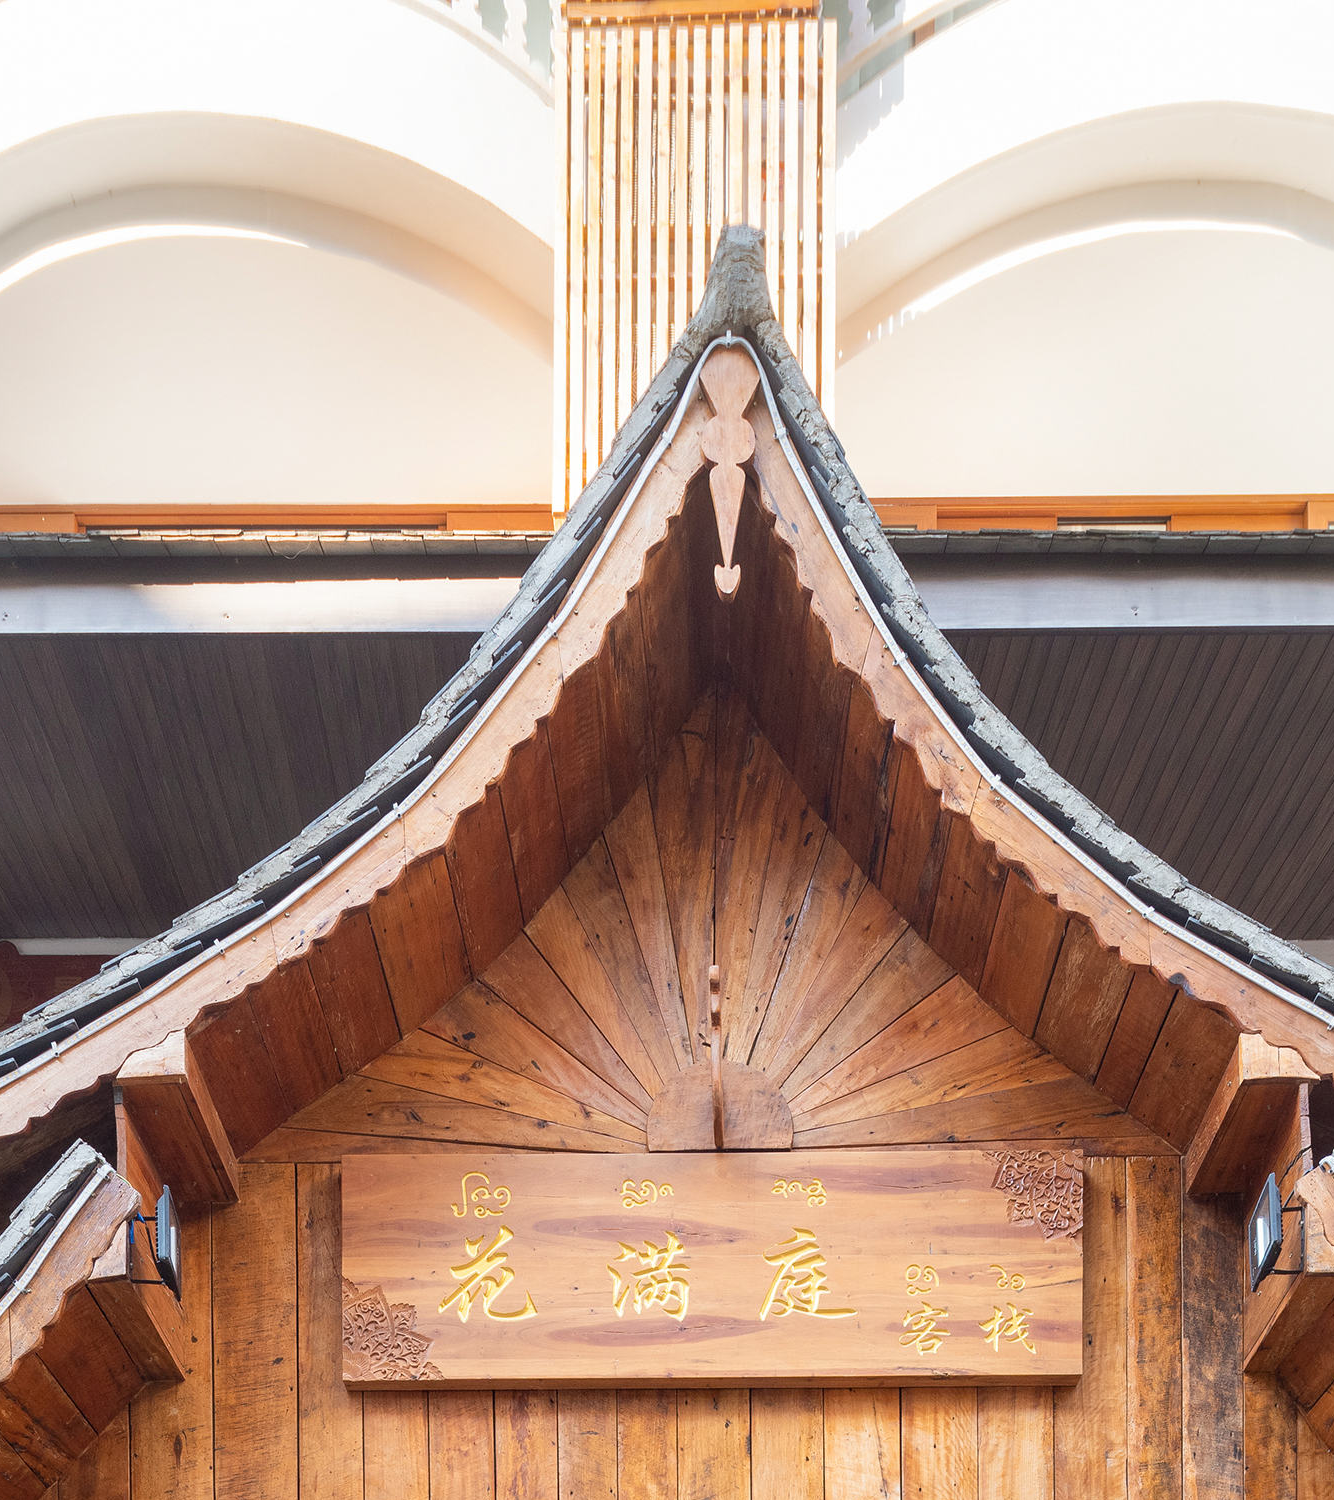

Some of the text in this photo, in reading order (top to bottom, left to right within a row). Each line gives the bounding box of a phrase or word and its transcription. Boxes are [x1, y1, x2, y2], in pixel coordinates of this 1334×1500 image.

[438, 1225, 858, 1322] 花满庭
[898, 1301, 1037, 1356] 客栈
